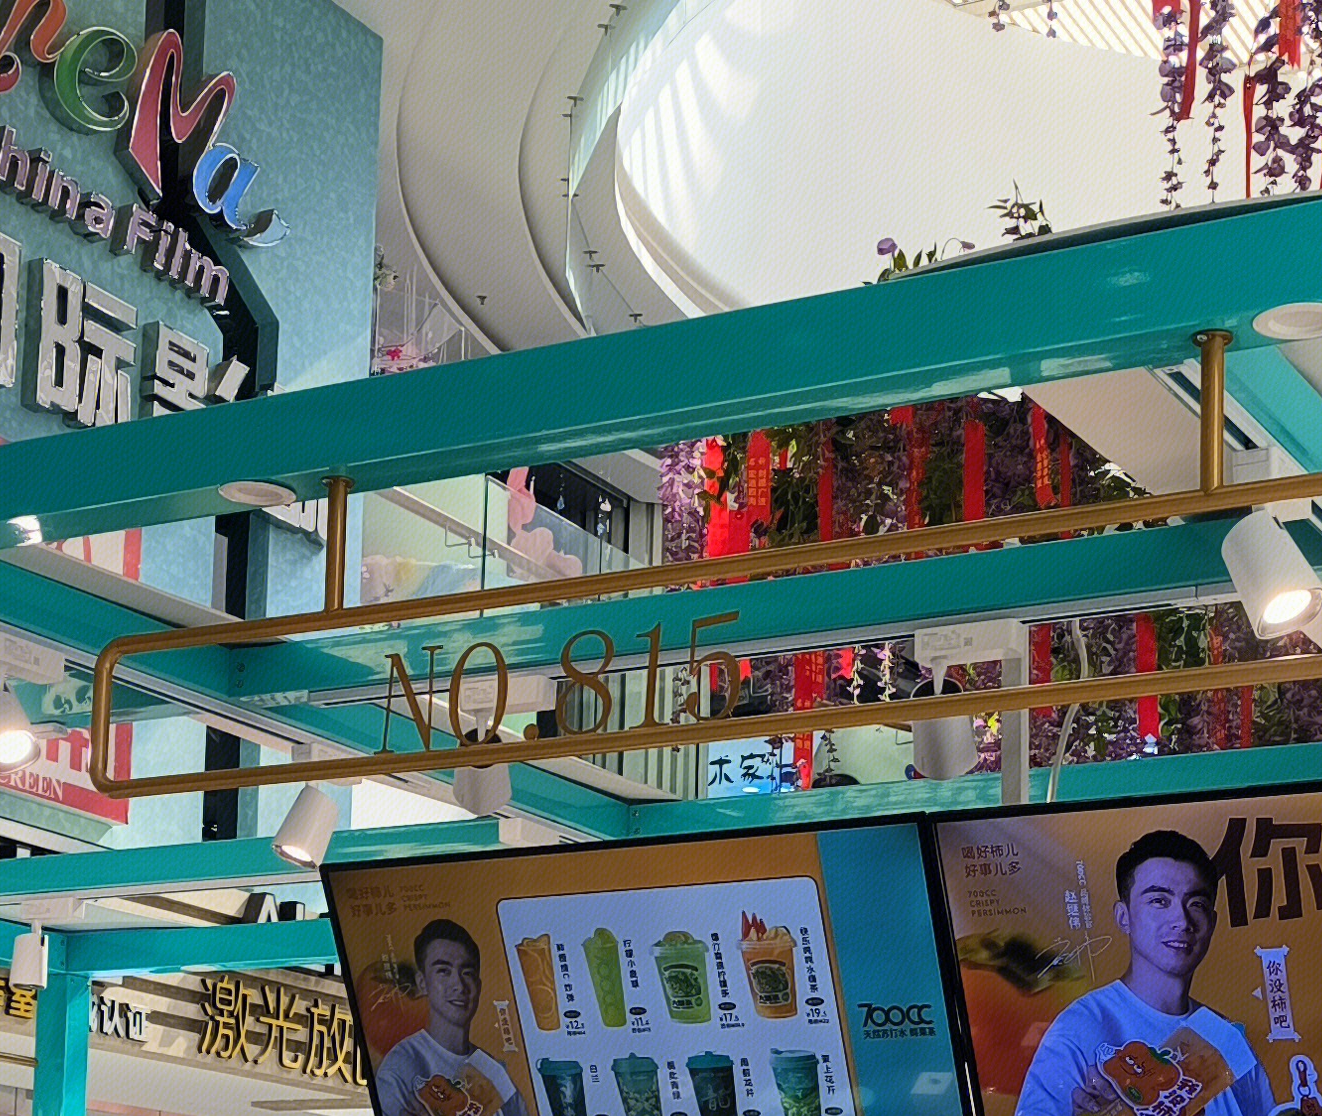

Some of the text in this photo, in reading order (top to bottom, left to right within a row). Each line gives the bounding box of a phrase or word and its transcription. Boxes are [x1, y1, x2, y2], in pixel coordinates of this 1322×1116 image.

[111, 203, 229, 306] Film
[962, 842, 1019, 861] 喝好柿儿
[964, 860, 1021, 879] 好事儿多
[968, 888, 997, 898] 700CC
[970, 898, 1000, 908] CRISPY
[971, 906, 1027, 918] PERSIMMON
[1265, 959, 1291, 1031] 你没柿吧
[856, 1003, 936, 1028] 700CC
[197, 975, 369, 1087] 激光放
